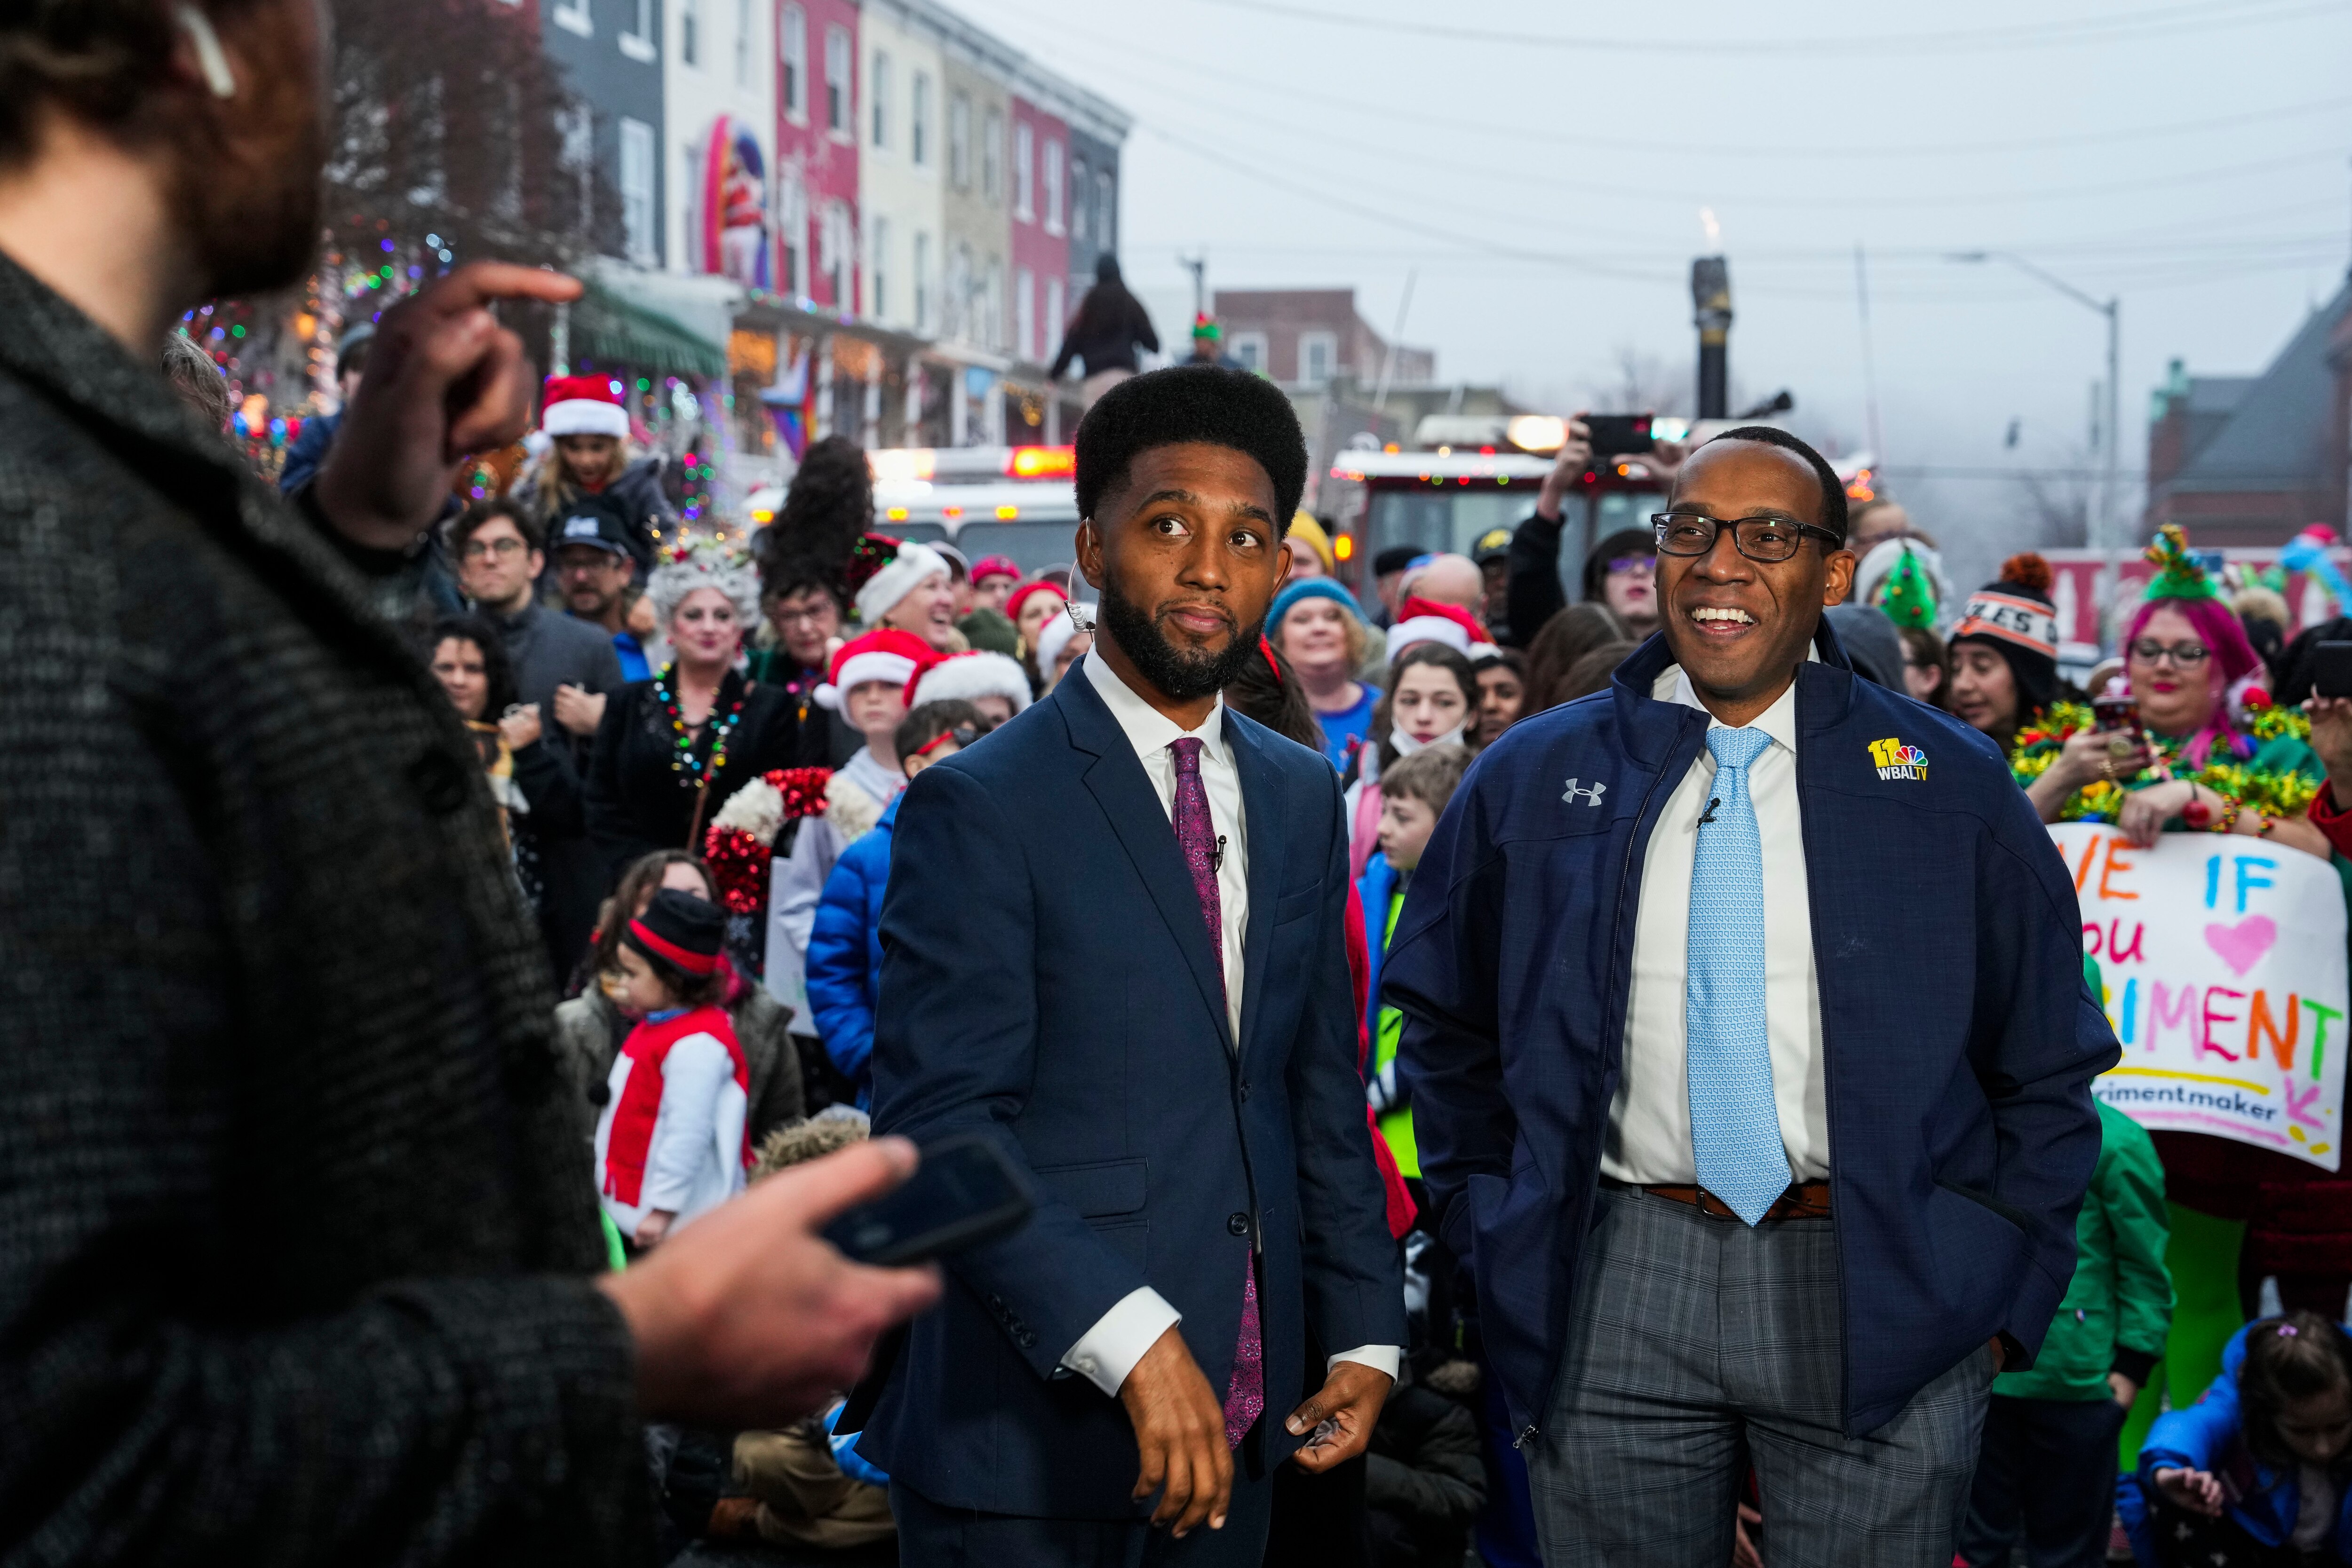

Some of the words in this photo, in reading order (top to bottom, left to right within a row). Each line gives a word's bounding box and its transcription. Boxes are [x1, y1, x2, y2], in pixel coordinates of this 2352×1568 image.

[1867, 737, 1901, 768] 11
[1876, 766, 1927, 781] WBALTV
[2205, 854, 2280, 913] IF
[2103, 977, 2344, 1081] IMENT
